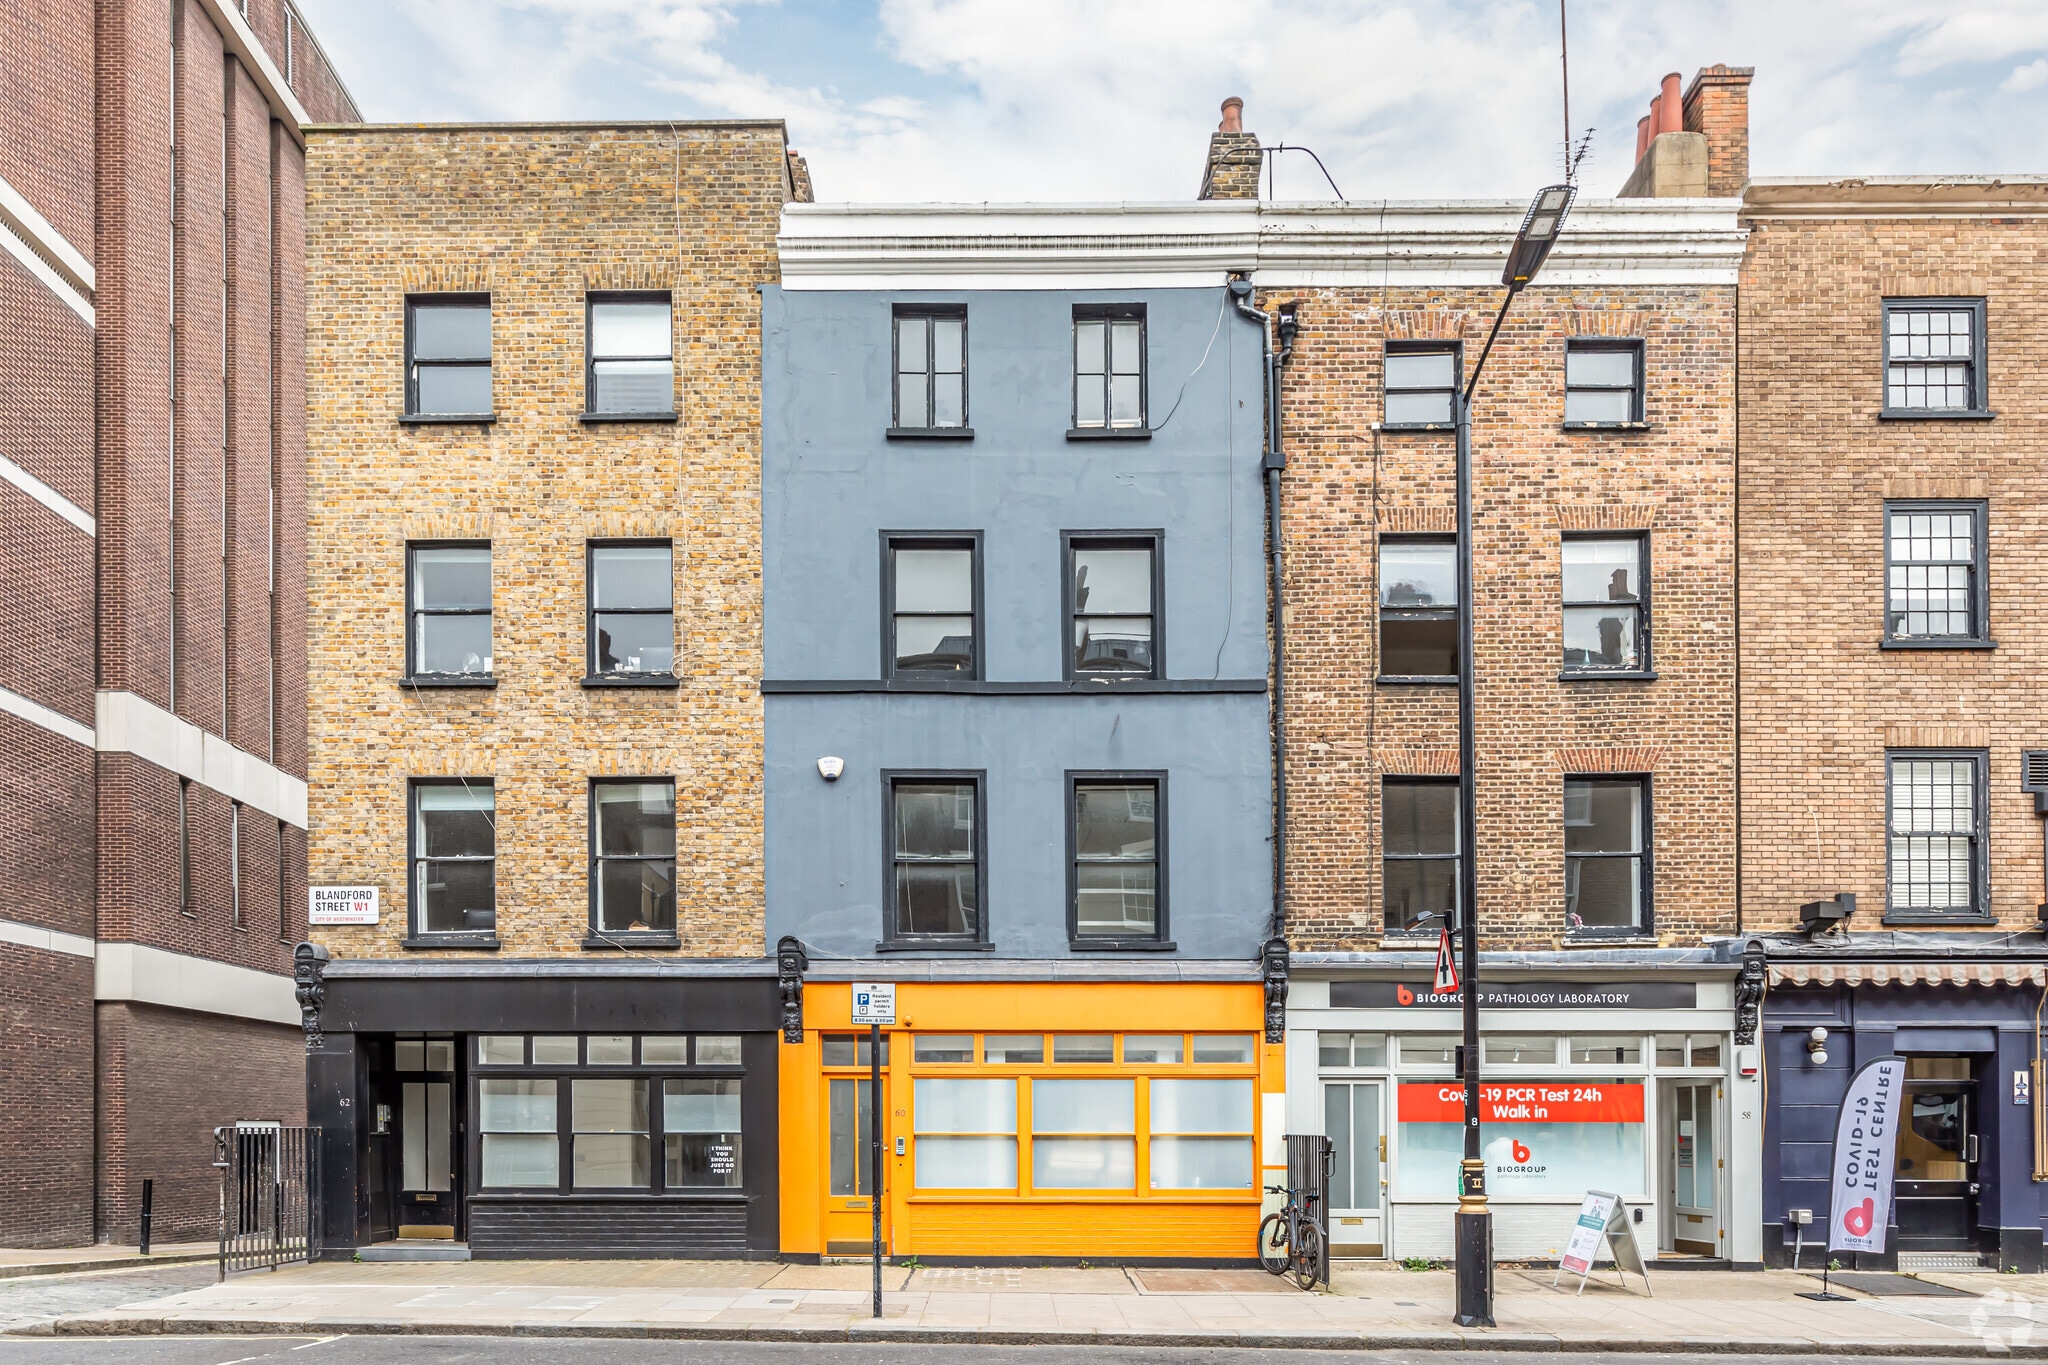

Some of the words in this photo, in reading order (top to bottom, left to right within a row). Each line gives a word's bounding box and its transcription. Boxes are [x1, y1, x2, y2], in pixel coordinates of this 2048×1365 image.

[315, 890, 372, 900] BLANDFORD
[315, 902, 350, 911] STREET
[354, 902, 368, 911] W1
[1416, 993, 1484, 1004] BIOGROP
[1488, 993, 1555, 1004] PATHOLOGY
[1558, 993, 1630, 1004] LABORATORY
[1438, 1088, 1502, 1102] Cov-19
[1506, 1088, 1535, 1101] PCR
[1539, 1088, 1569, 1101] Test
[1573, 1088, 1602, 1101] 24h
[339, 1098, 351, 1107] 62
[895, 1109, 906, 1117] 60
[1493, 1104, 1531, 1118] Walk
[1534, 1104, 1548, 1118] in
[1741, 1111, 1752, 1120] 58
[1471, 1117, 1478, 1126] 8
